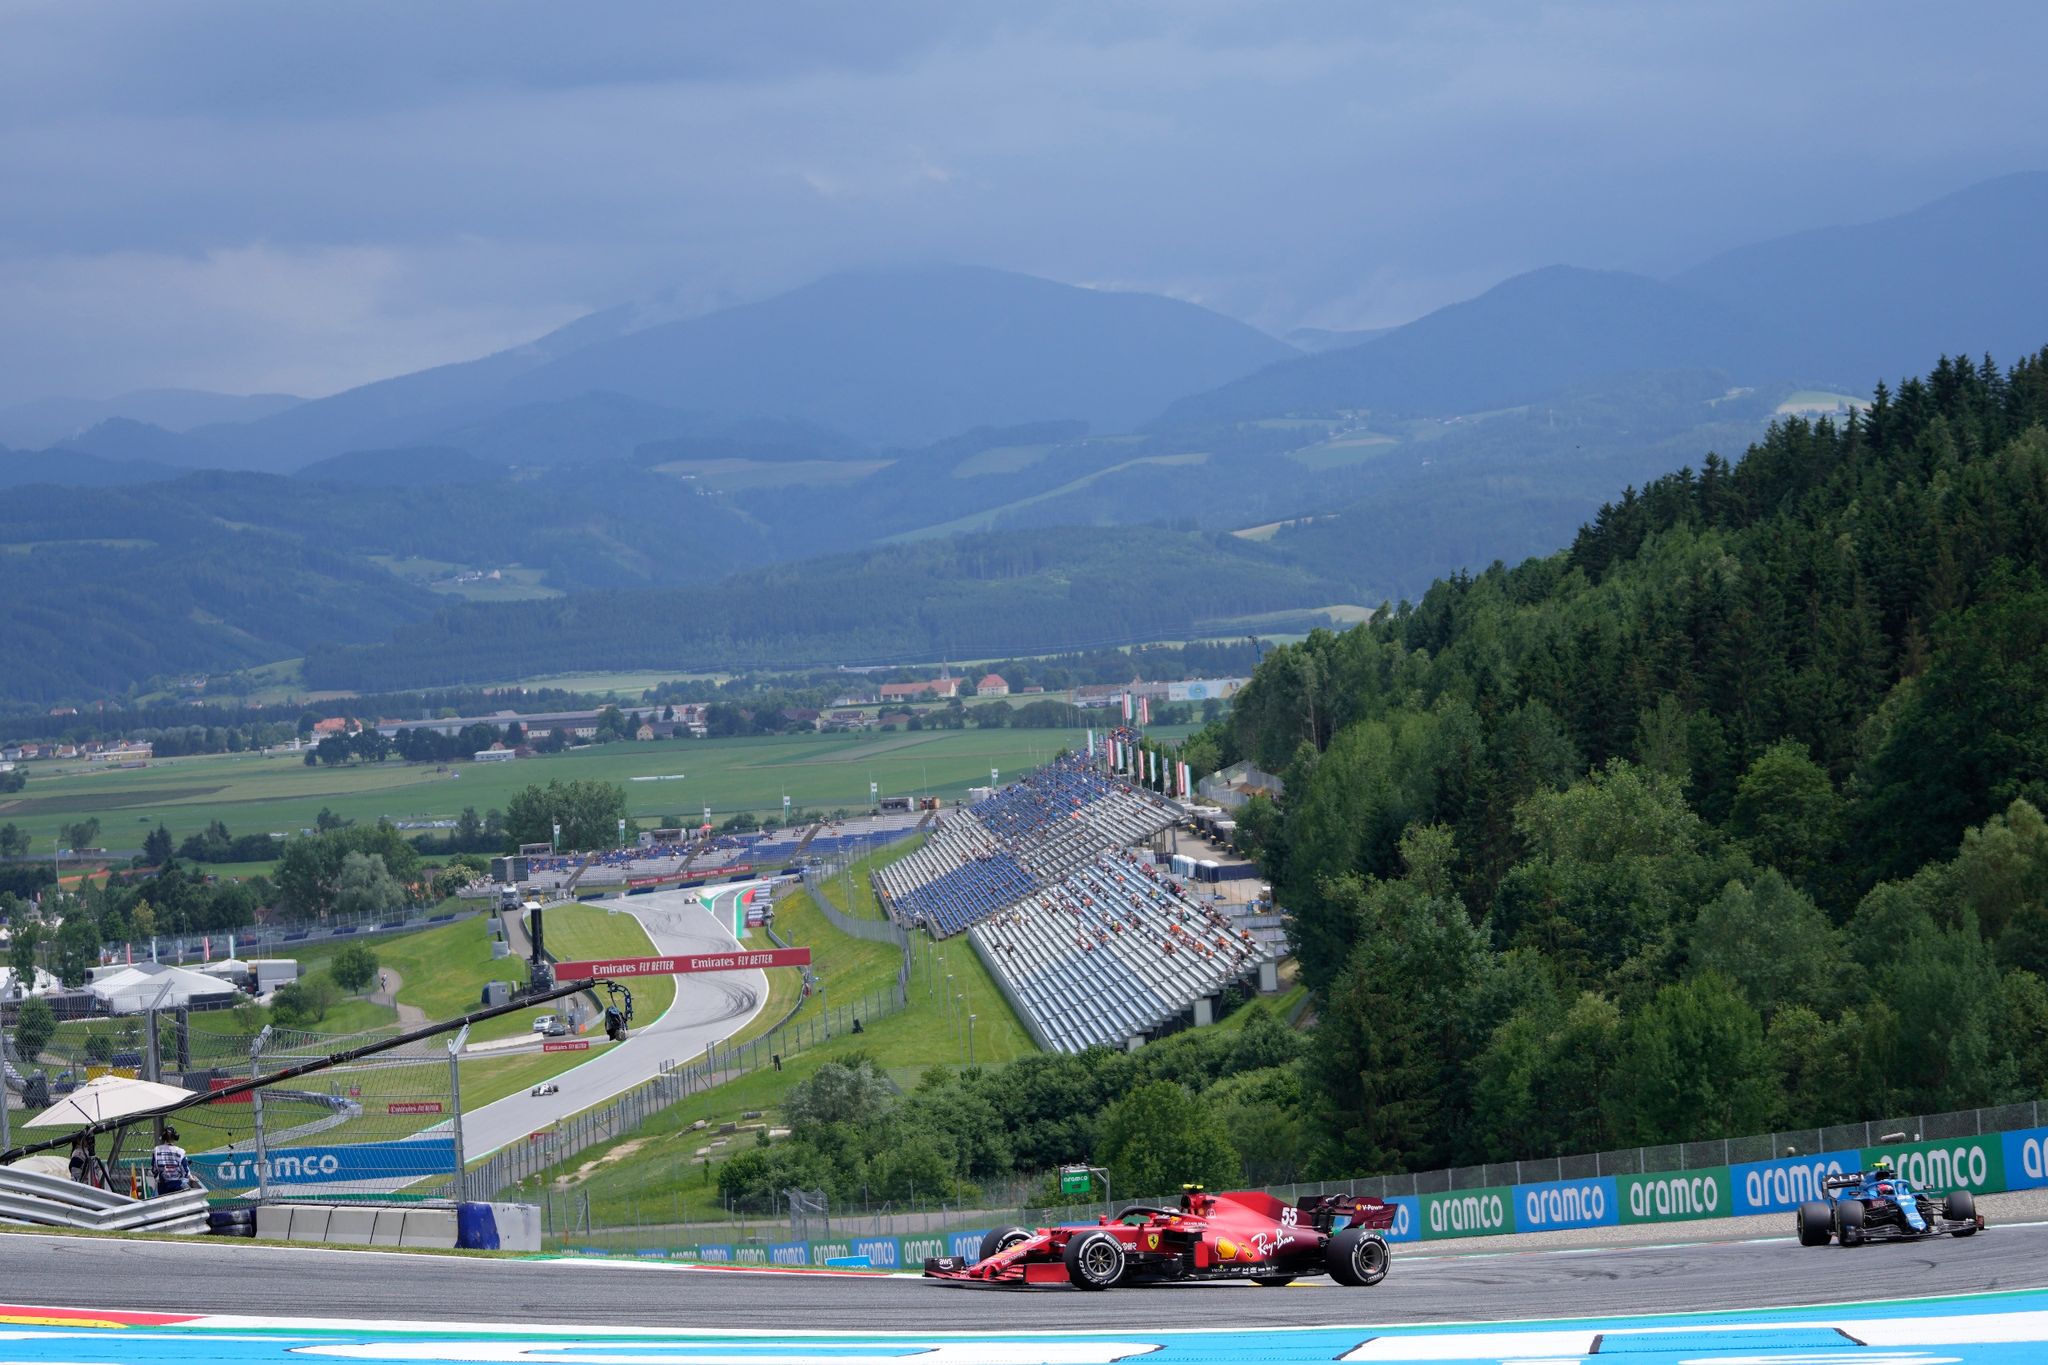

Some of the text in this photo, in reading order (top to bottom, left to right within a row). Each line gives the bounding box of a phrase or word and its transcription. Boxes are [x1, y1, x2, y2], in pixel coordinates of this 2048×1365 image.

[593, 960, 674, 976] Emirates FLY BETTER
[691, 954, 773, 969] Emirates FLY BETTER
[545, 1043, 567, 1051] Emirates
[217, 1153, 339, 1181] aramco
[1746, 1161, 1842, 1206] aramco
[1828, 1174, 1865, 1183] ALPI
[1527, 1185, 1605, 1224] aramco
[1630, 1176, 1718, 1216] aramco
[1281, 1207, 1298, 1226] 55
[1430, 1195, 1504, 1232] aramco
[859, 1242, 894, 1264] aramco
[904, 1239, 943, 1263] aramco
[1251, 1229, 1295, 1256] Ray-Ban
[736, 1246, 765, 1263] aramco
[774, 1246, 805, 1265] aramco
[814, 1244, 847, 1265] aramco
